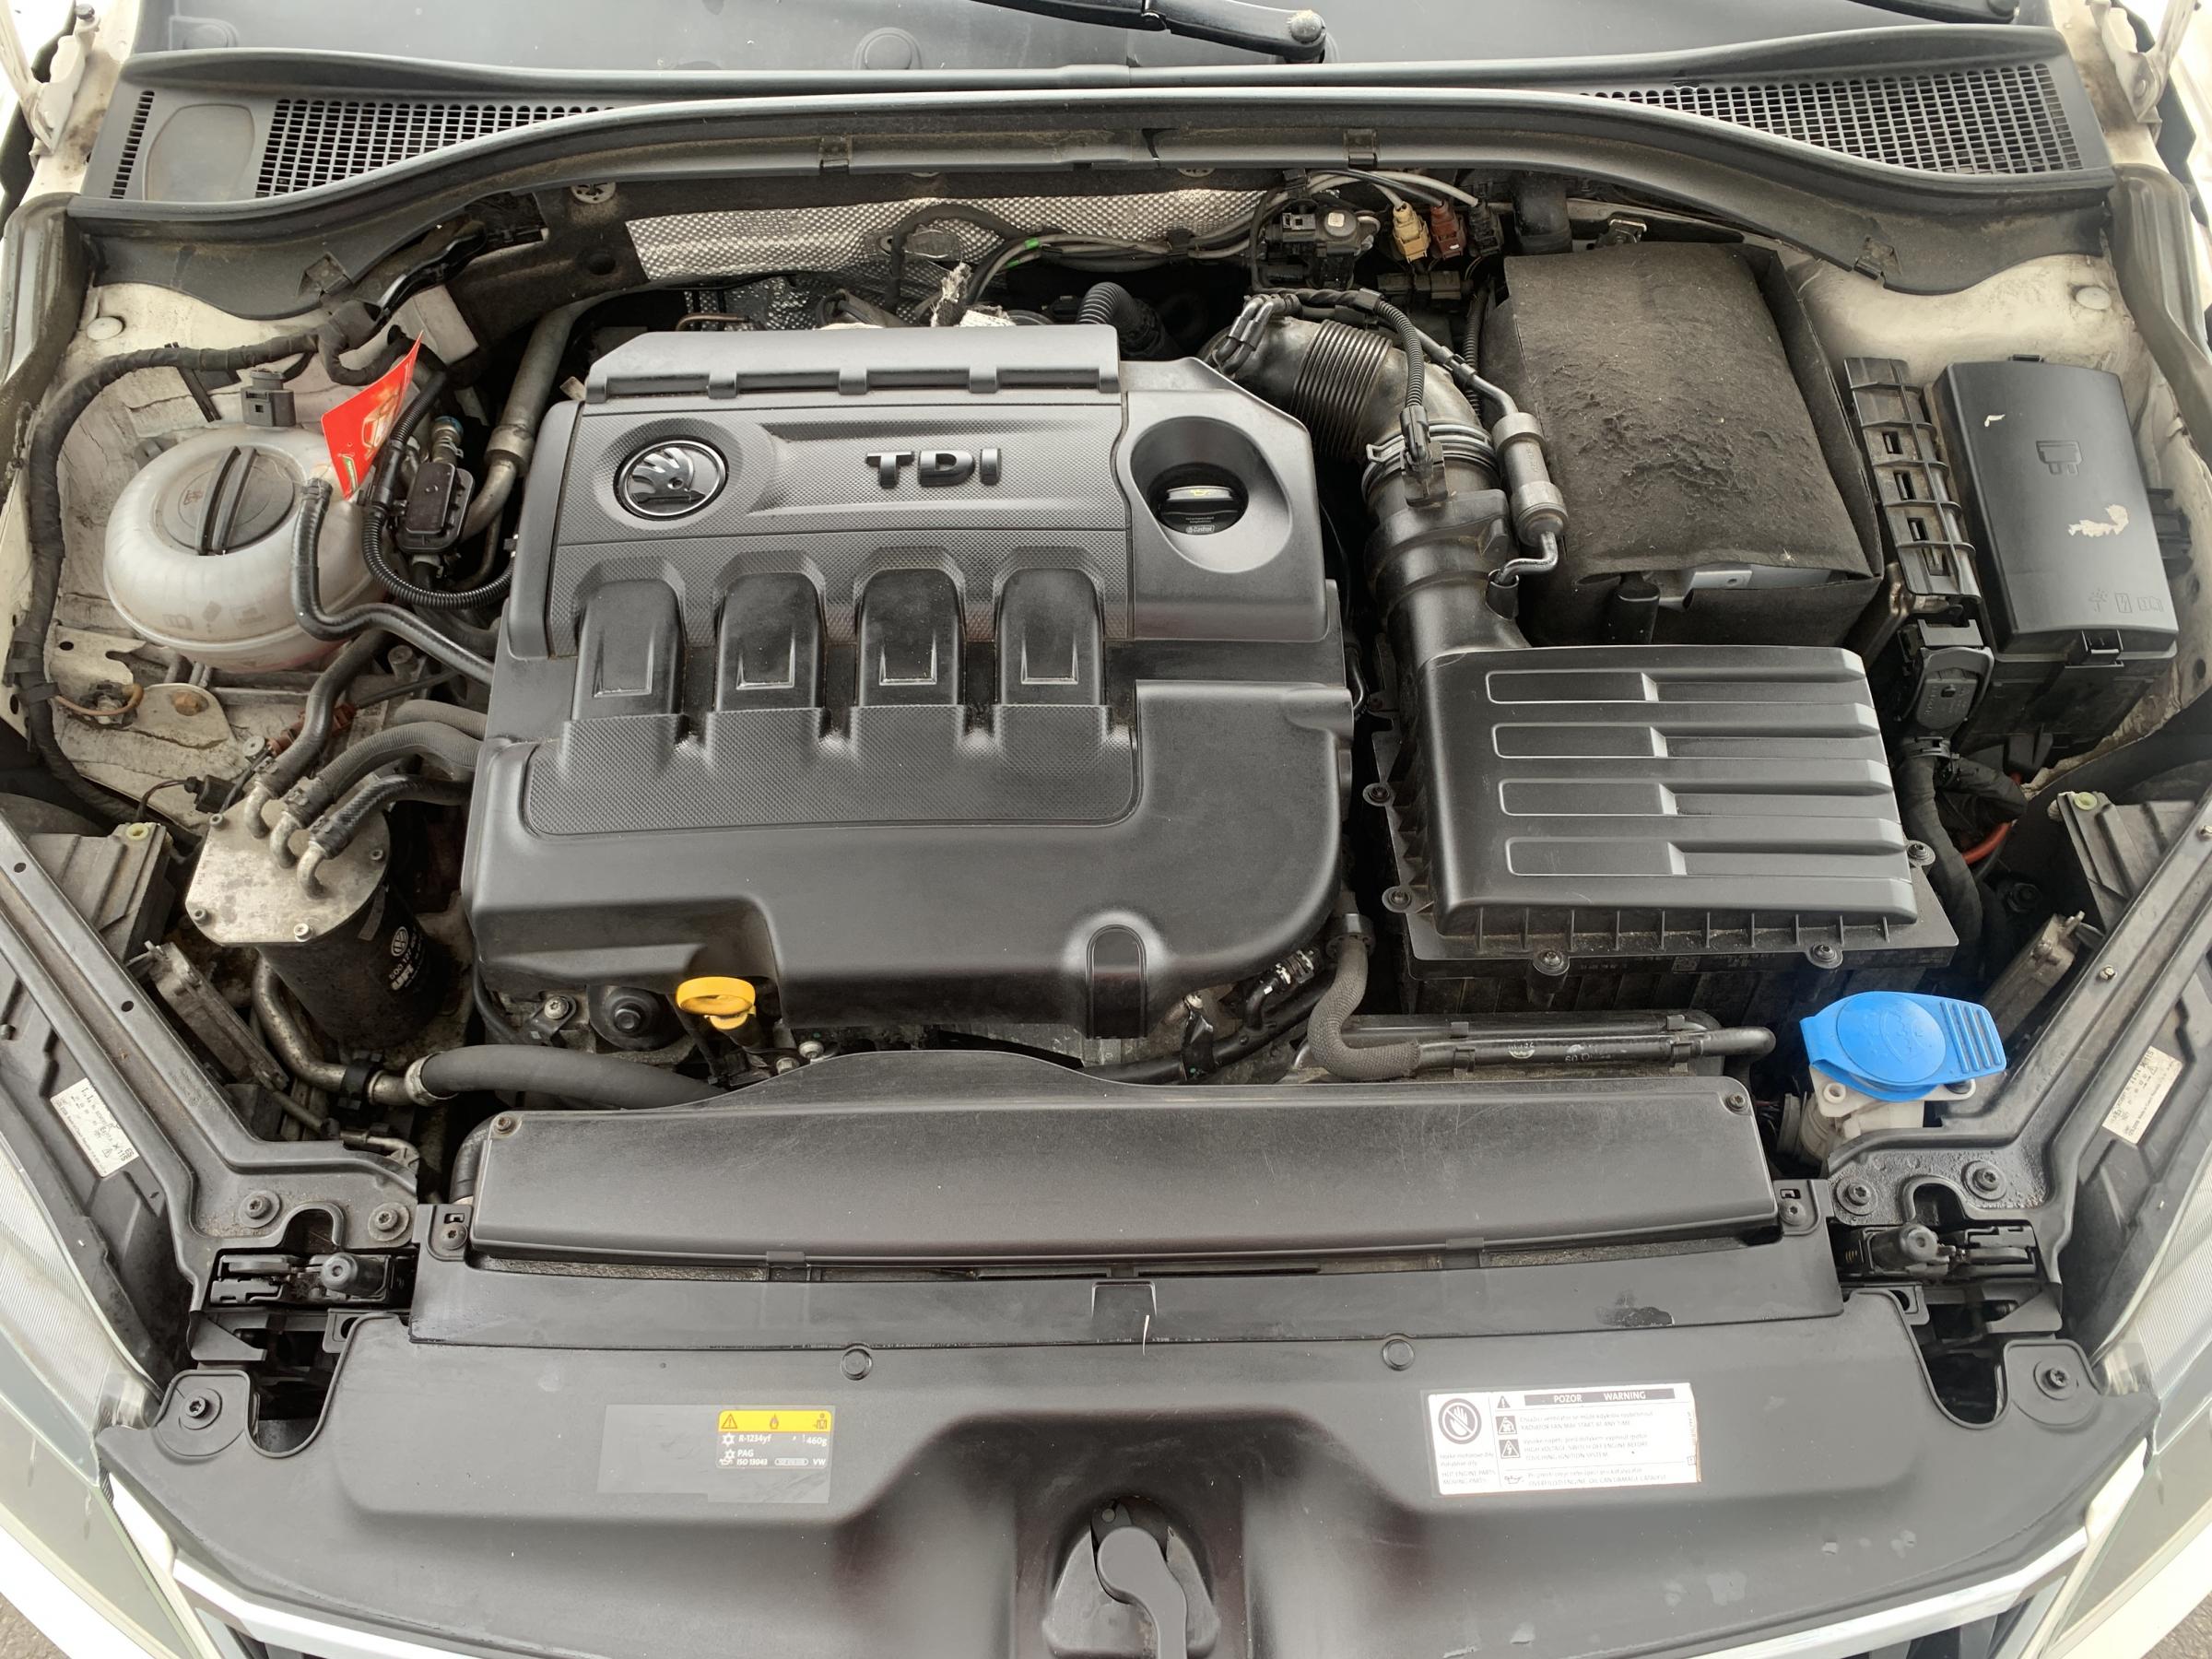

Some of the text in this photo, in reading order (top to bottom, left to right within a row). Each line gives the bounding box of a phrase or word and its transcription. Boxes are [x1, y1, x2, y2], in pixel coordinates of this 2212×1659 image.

[865, 448, 1002, 489] TDI
[1554, 1391, 1646, 1403] POZOR WARNING
[738, 1434, 828, 1446] R-1234yf 460g
[737, 1449, 754, 1457] PAG
